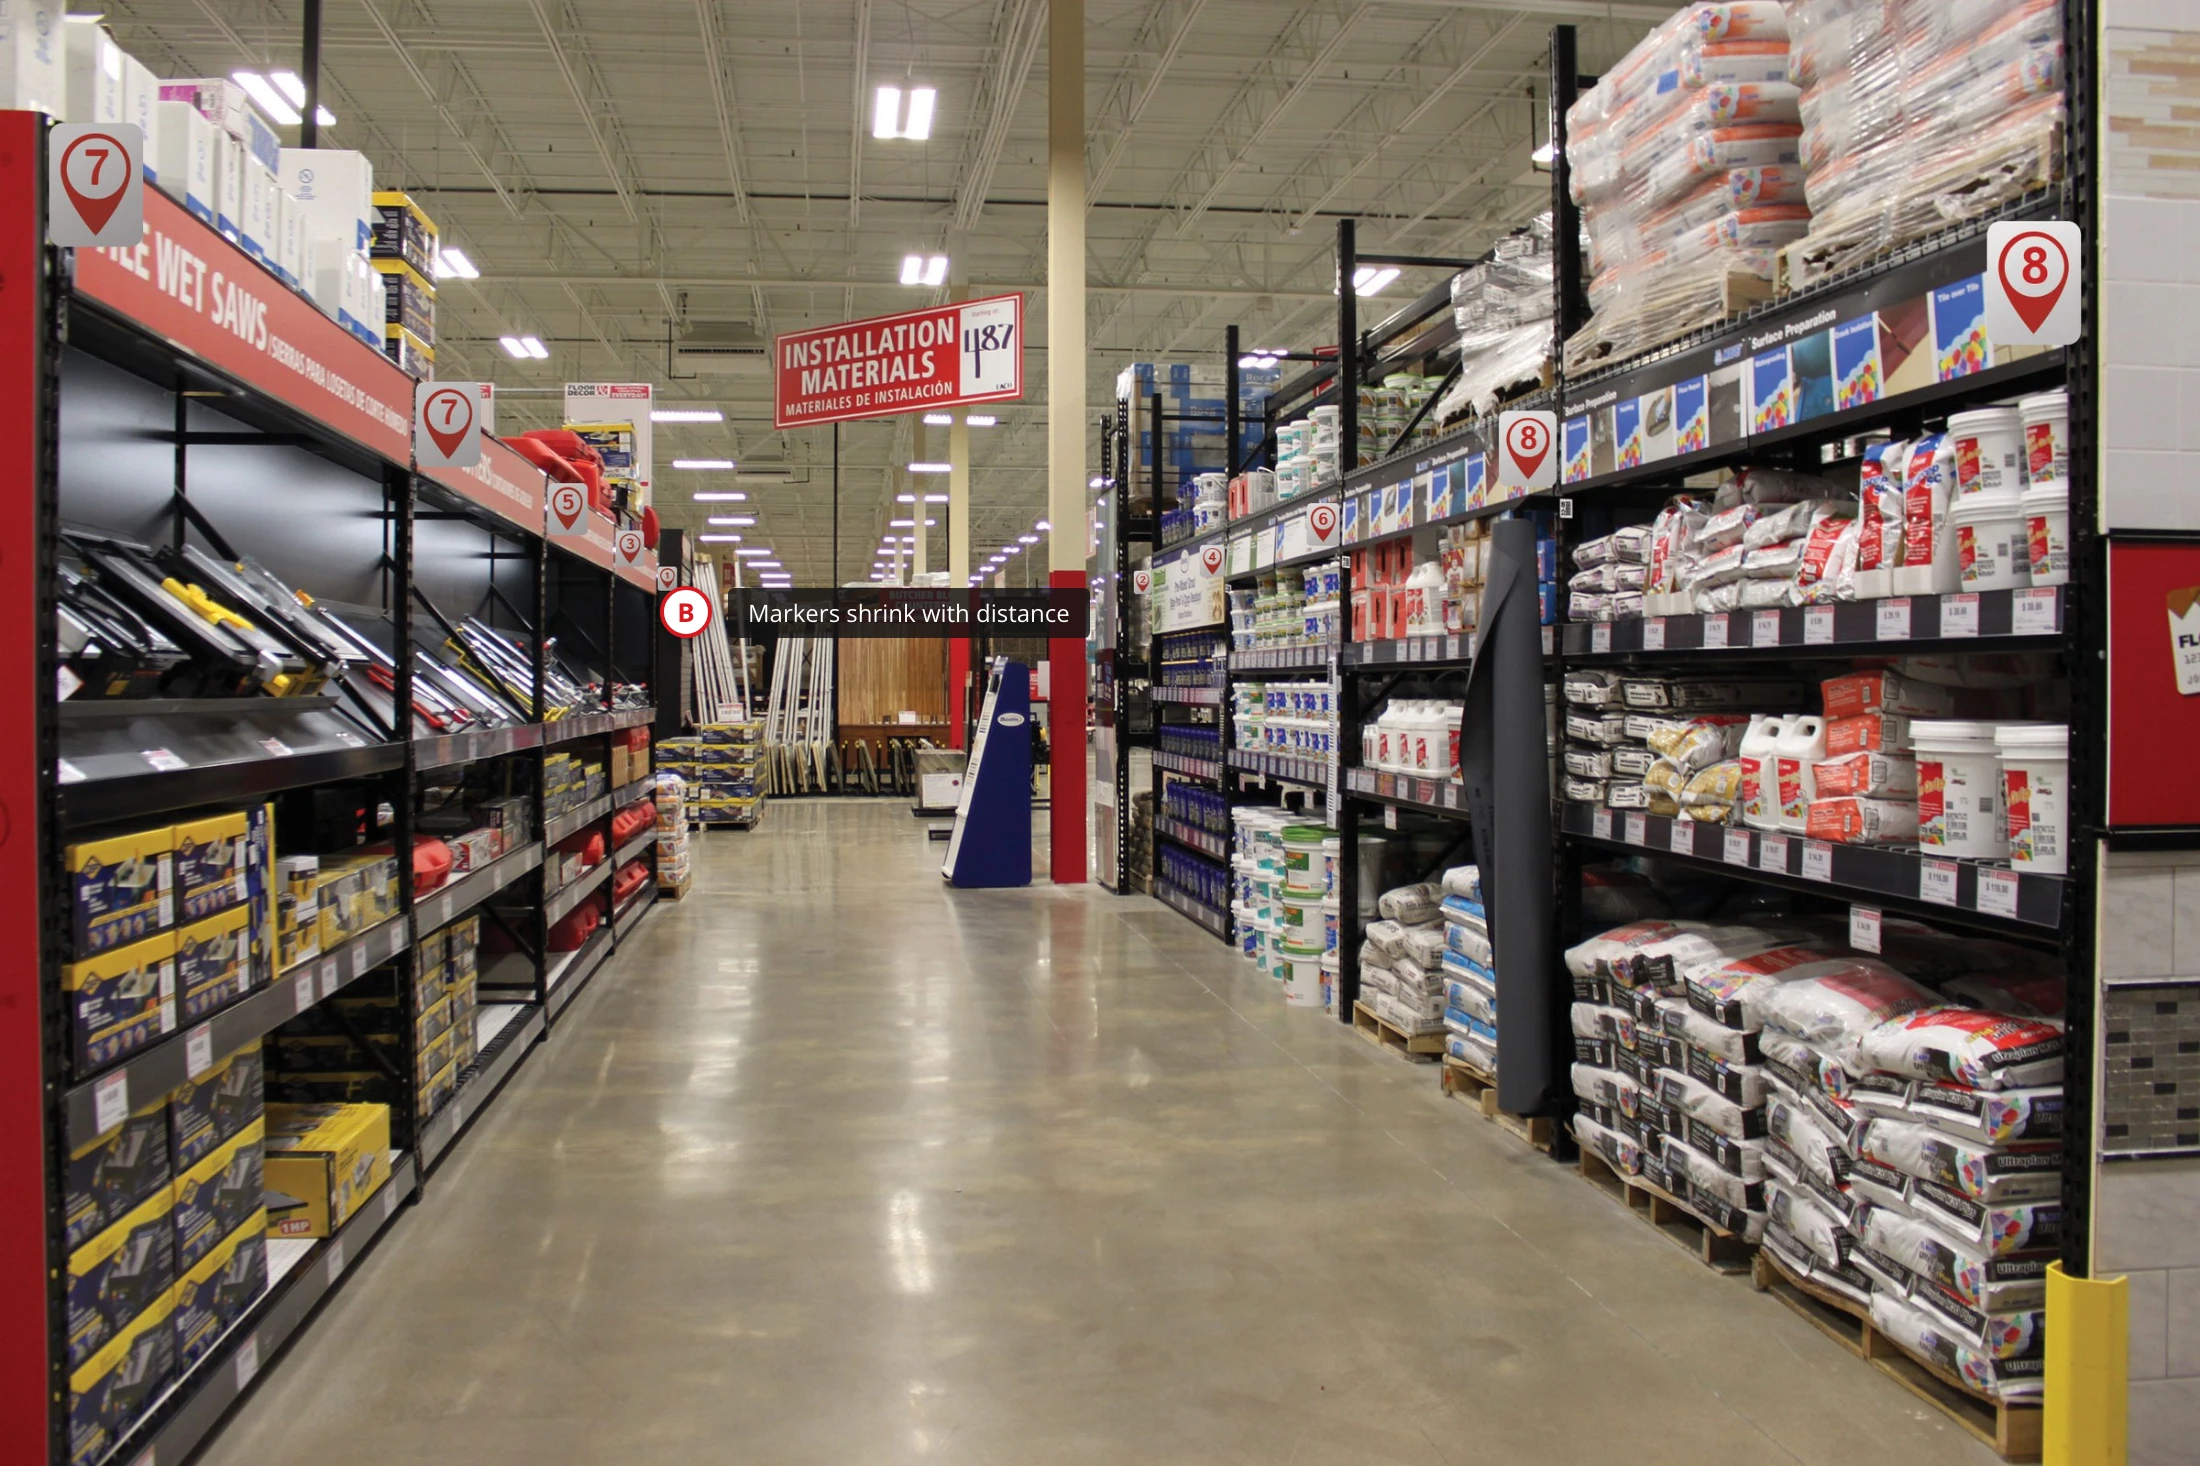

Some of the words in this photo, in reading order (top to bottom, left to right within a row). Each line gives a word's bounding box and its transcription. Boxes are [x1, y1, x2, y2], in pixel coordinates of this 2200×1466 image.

[1937, 293, 1950, 303] Tile
[1966, 282, 1980, 293] Tile
[155, 231, 207, 313] WET
[211, 272, 269, 351] SAWS
[305, 357, 326, 389] PARA
[971, 309, 990, 318] Starting
[1751, 331, 1783, 350] Surface
[1784, 309, 1837, 338] Preparation
[785, 316, 955, 370] INSTALLATION
[801, 351, 936, 396] MATERIALS
[1245, 373, 1271, 382] Roca
[995, 381, 1013, 391] EACH
[785, 396, 852, 417] MATERIALES
[856, 392, 870, 407] DE
[874, 379, 953, 404] INSTALACIÓN
[1564, 402, 1585, 417] Surface
[1585, 391, 1617, 409] Preparation
[889, 591, 933, 600] BUTCHER
[2178, 633, 2200, 649] FL
[1998, 1154, 2048, 1168] Ultraplan
